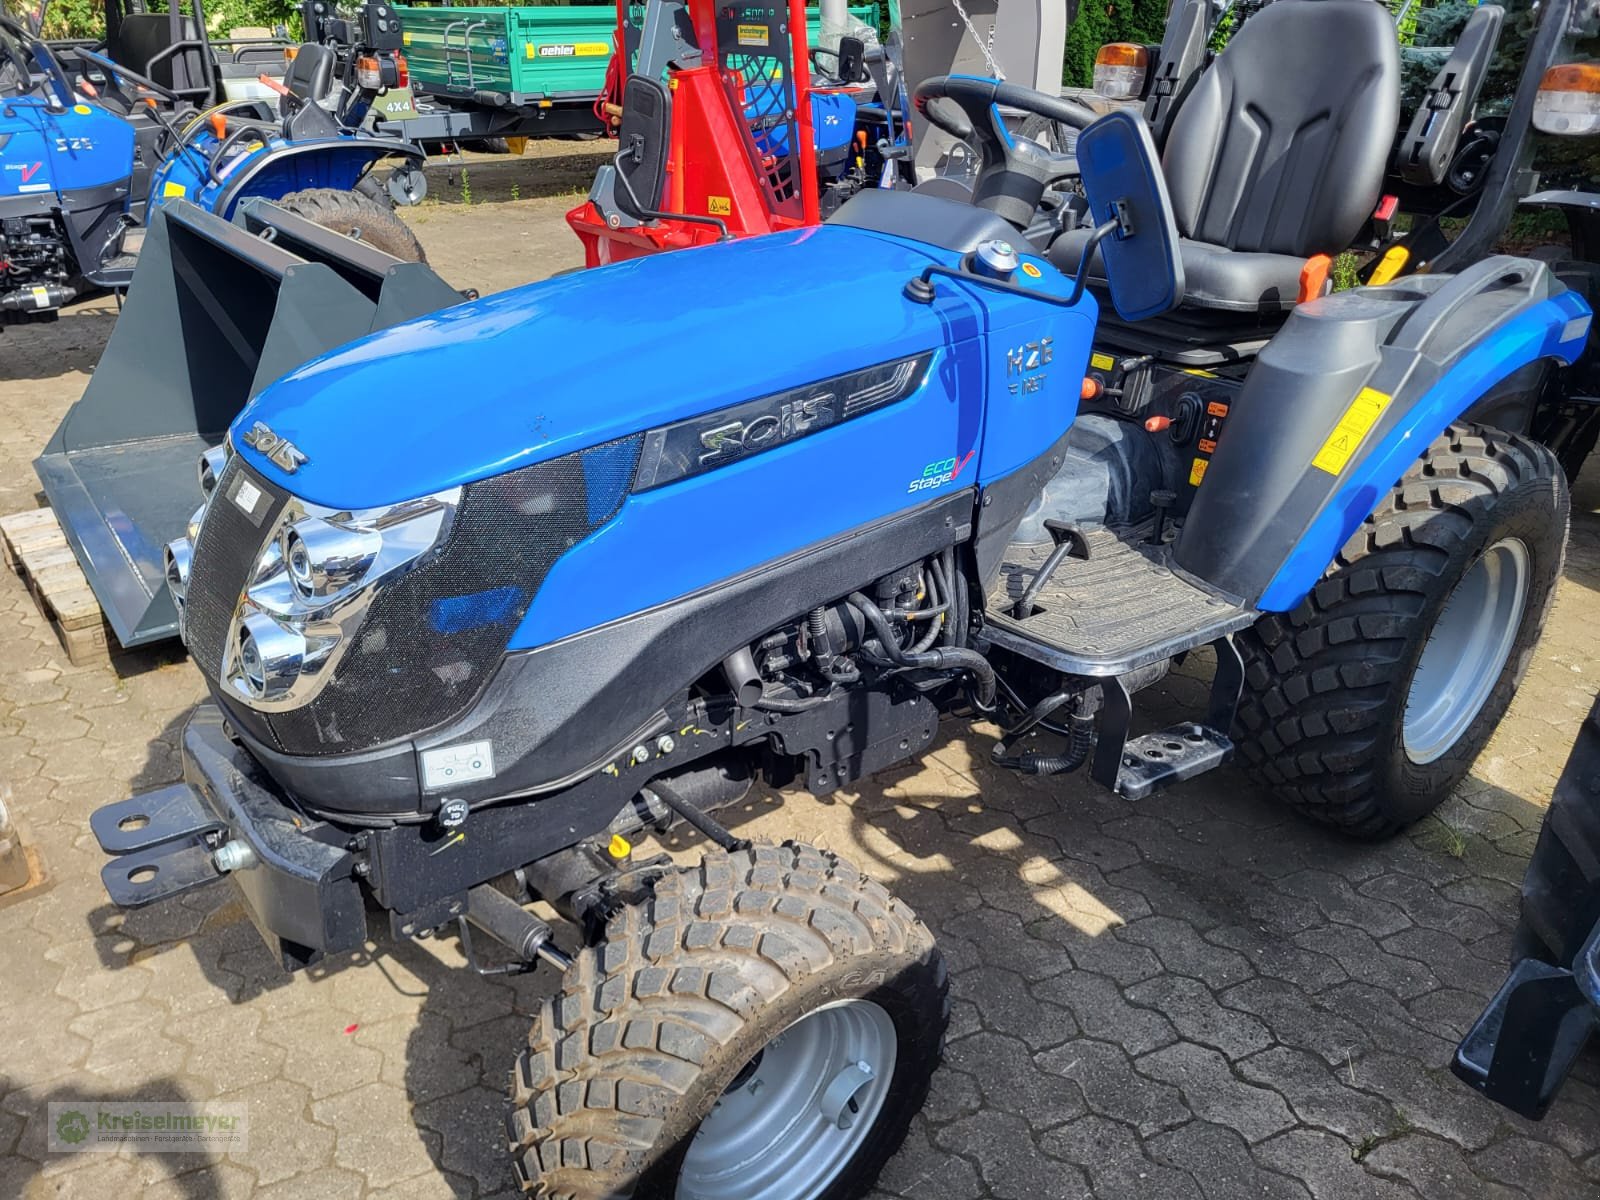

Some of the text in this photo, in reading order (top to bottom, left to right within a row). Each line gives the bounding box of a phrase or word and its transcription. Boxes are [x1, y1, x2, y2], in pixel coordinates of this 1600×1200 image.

[541, 45, 574, 56] oehler
[907, 450, 976, 494] Stage V
[923, 457, 957, 477] ECO
[446, 804, 465, 814] PULL
